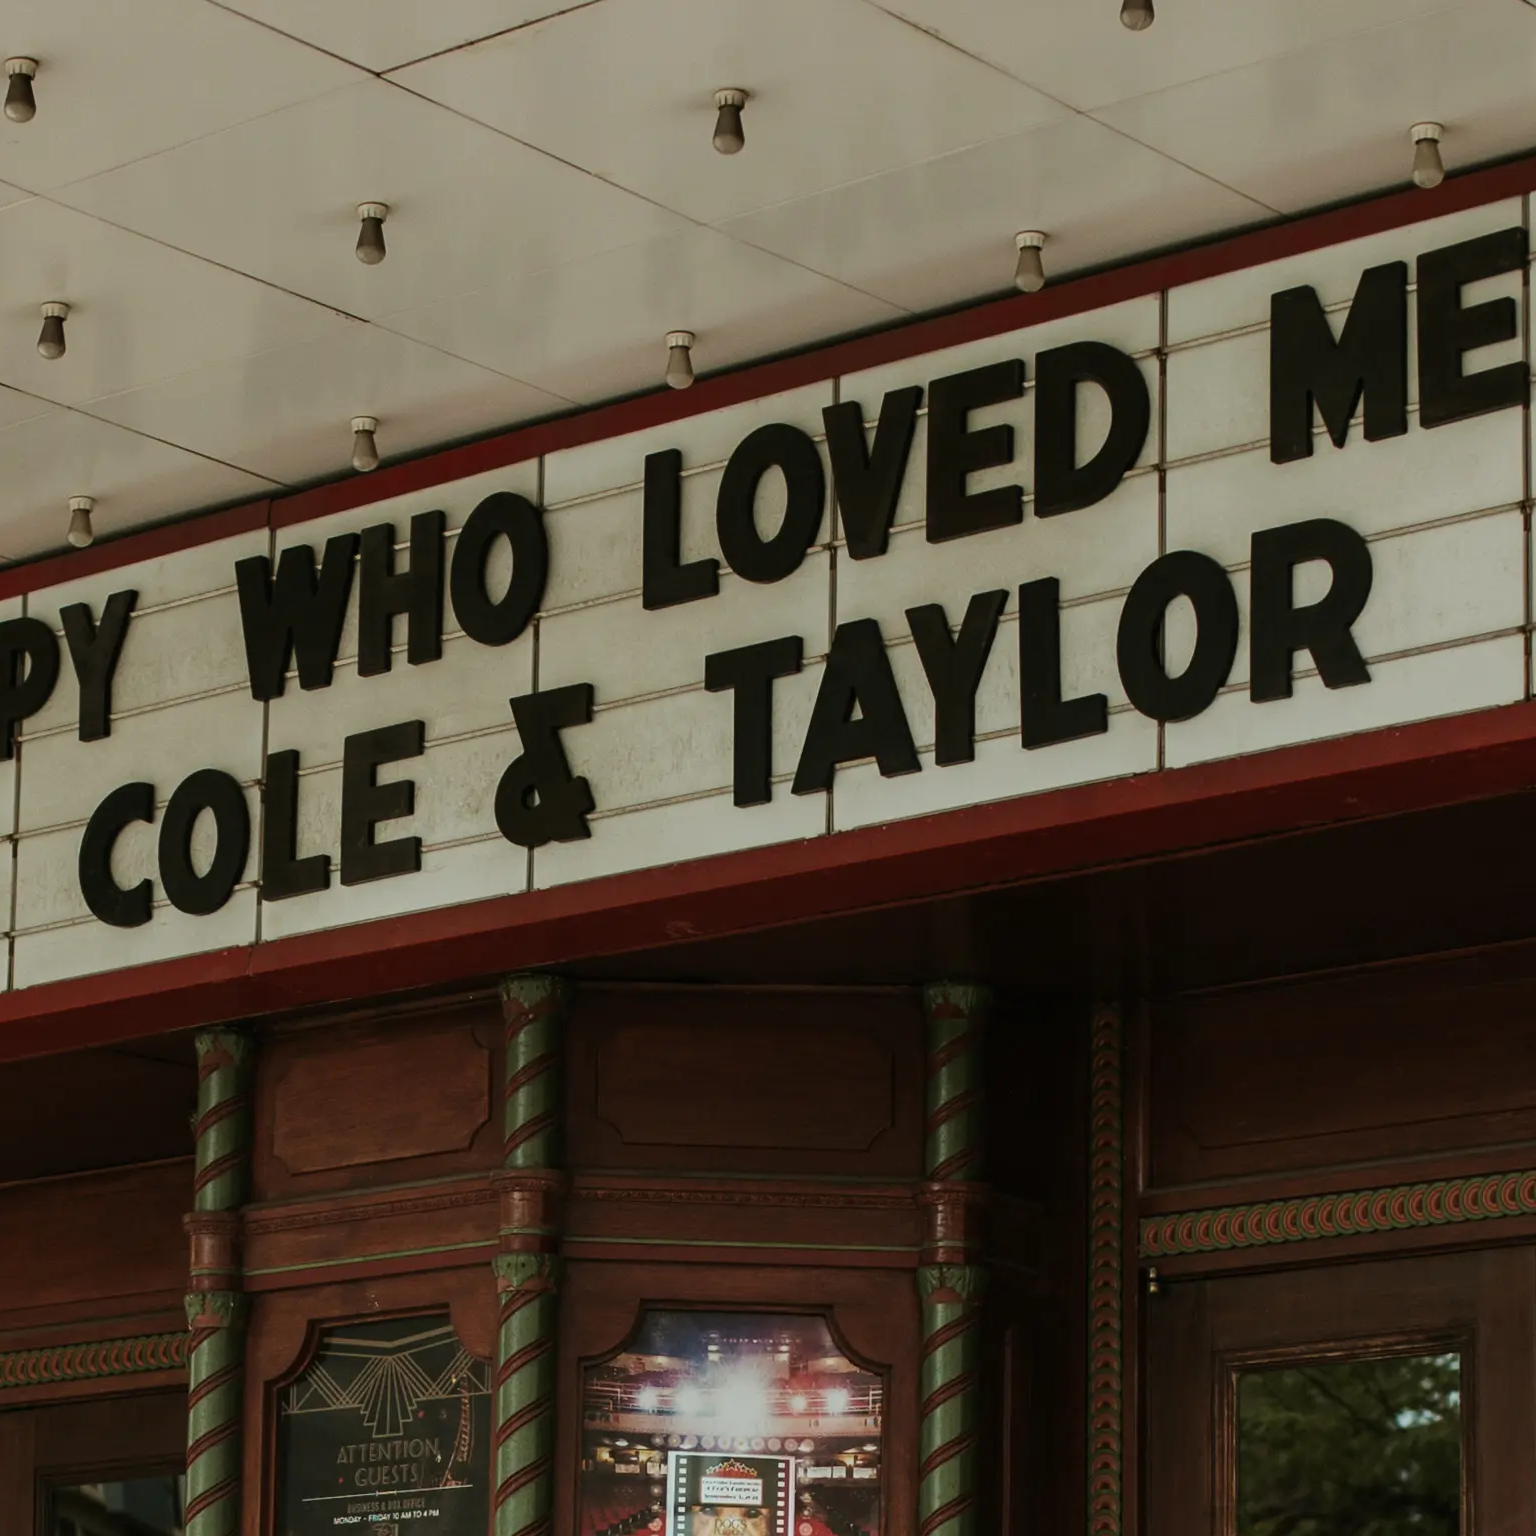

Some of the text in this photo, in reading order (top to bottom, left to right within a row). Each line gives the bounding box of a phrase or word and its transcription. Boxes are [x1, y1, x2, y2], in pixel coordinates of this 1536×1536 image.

[234, 491, 549, 702] WHO
[642, 340, 1151, 611] LOVED
[1268, 226, 1531, 467] ME
[78, 719, 425, 928] COLE
[494, 682, 595, 848] &
[704, 518, 1373, 808] TAYLOR
[337, 1438, 440, 1464] ATTENTION
[355, 1463, 419, 1487] GUESTS
